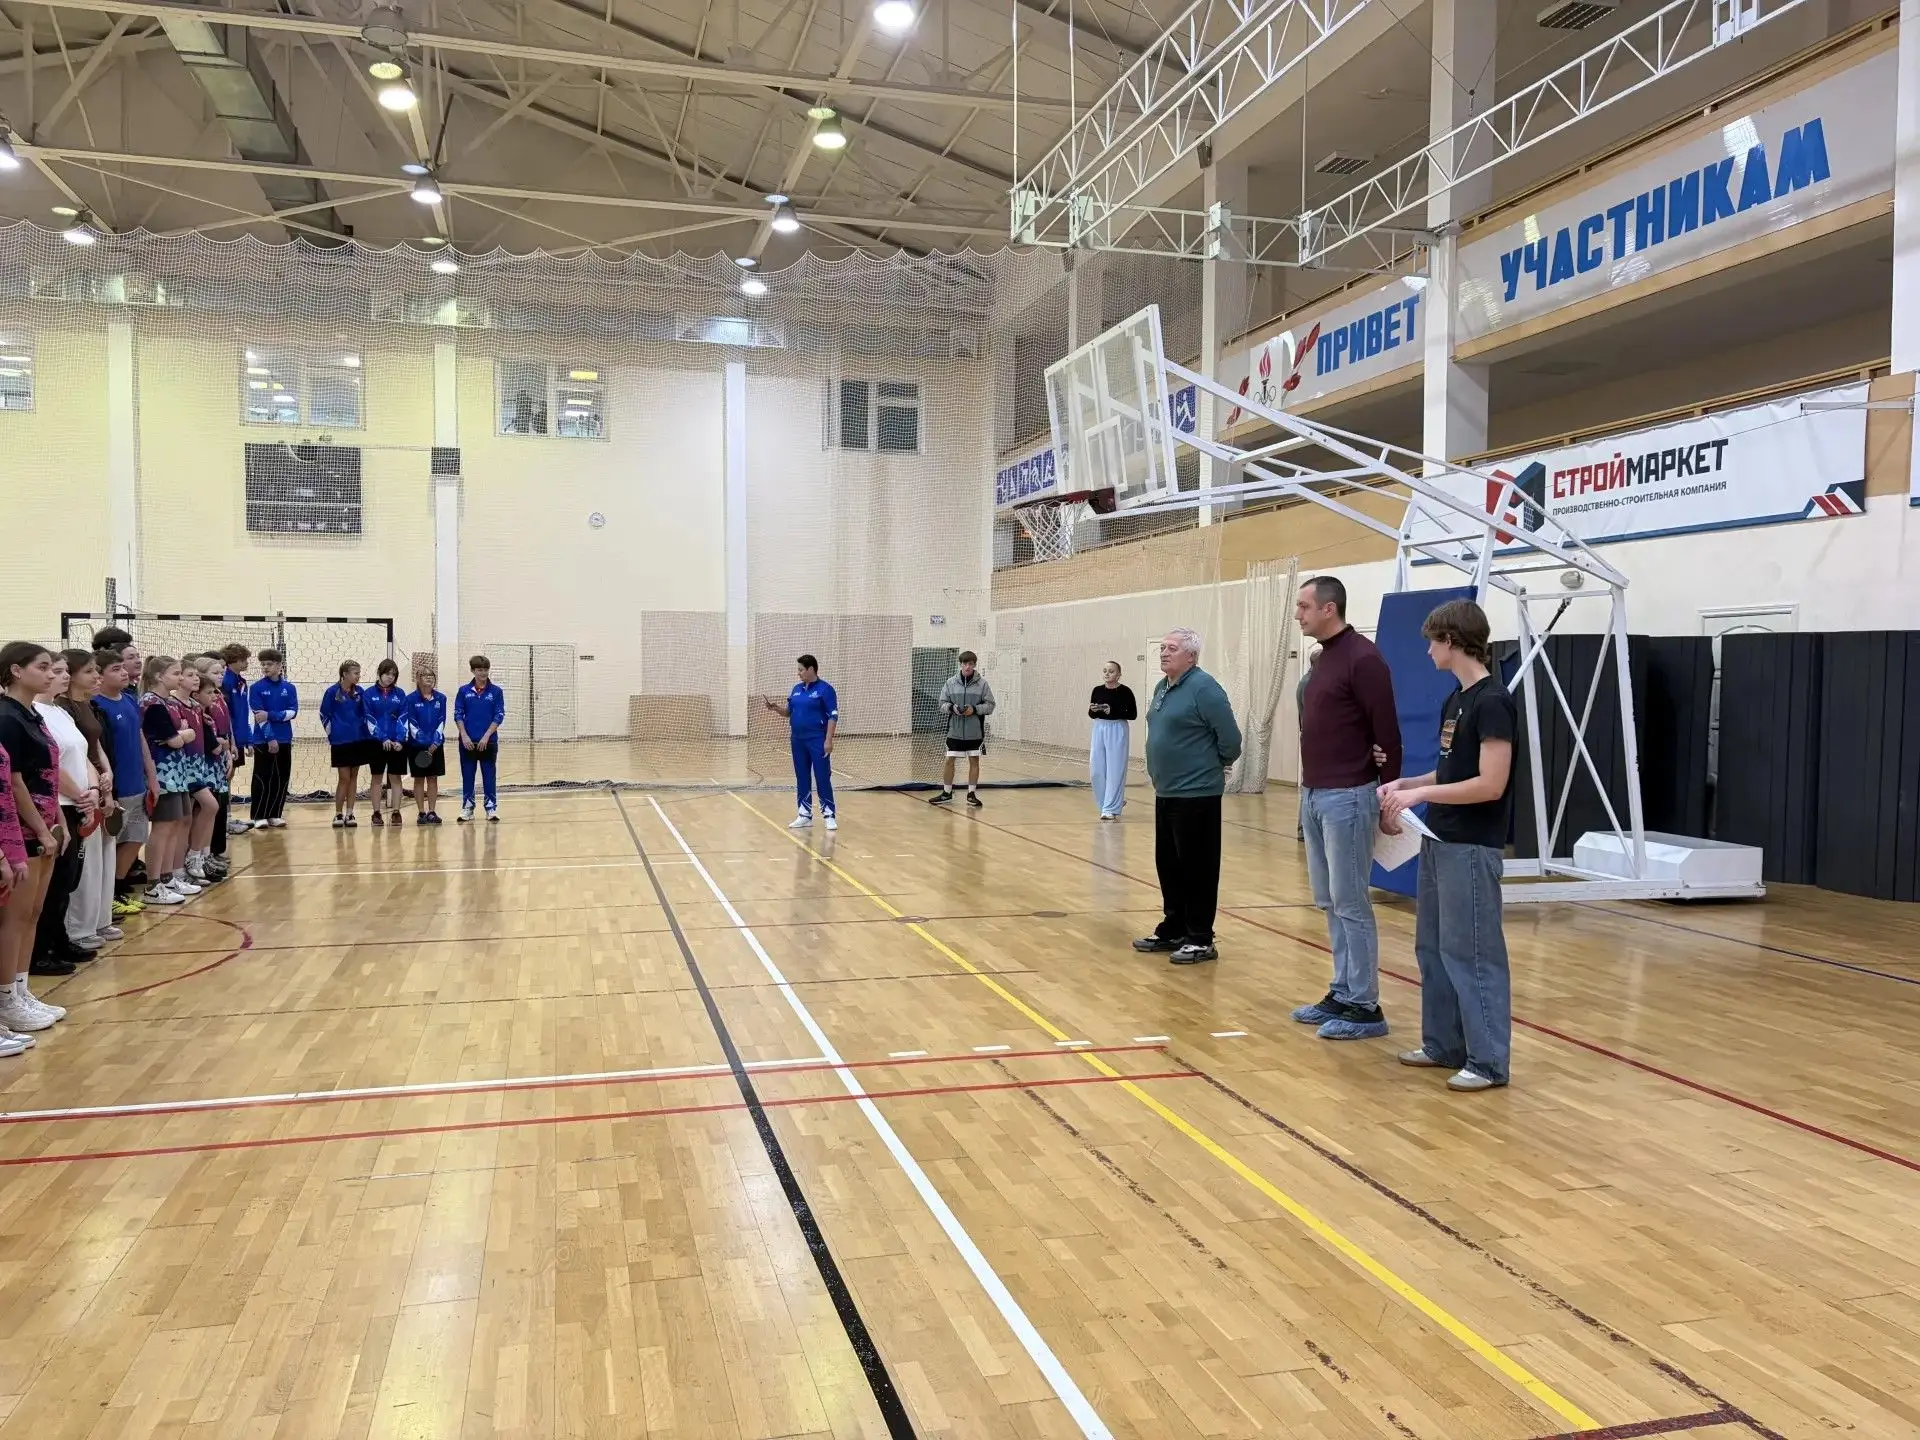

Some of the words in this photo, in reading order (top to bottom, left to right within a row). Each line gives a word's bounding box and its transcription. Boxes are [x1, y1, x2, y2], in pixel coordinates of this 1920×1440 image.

[1500, 117, 1831, 303] УЧАСТНИКАМ
[1317, 294, 1420, 376] ПРИВЕТ
[1552, 488, 1679, 516] ПРОИЗВОДСТВЕННО-СТРОИТЕЛЬНАЯ
[1680, 481, 1727, 497] КОМПАНИЯ
[1553, 439, 1729, 499] СТРОЙМАРКЕТ
